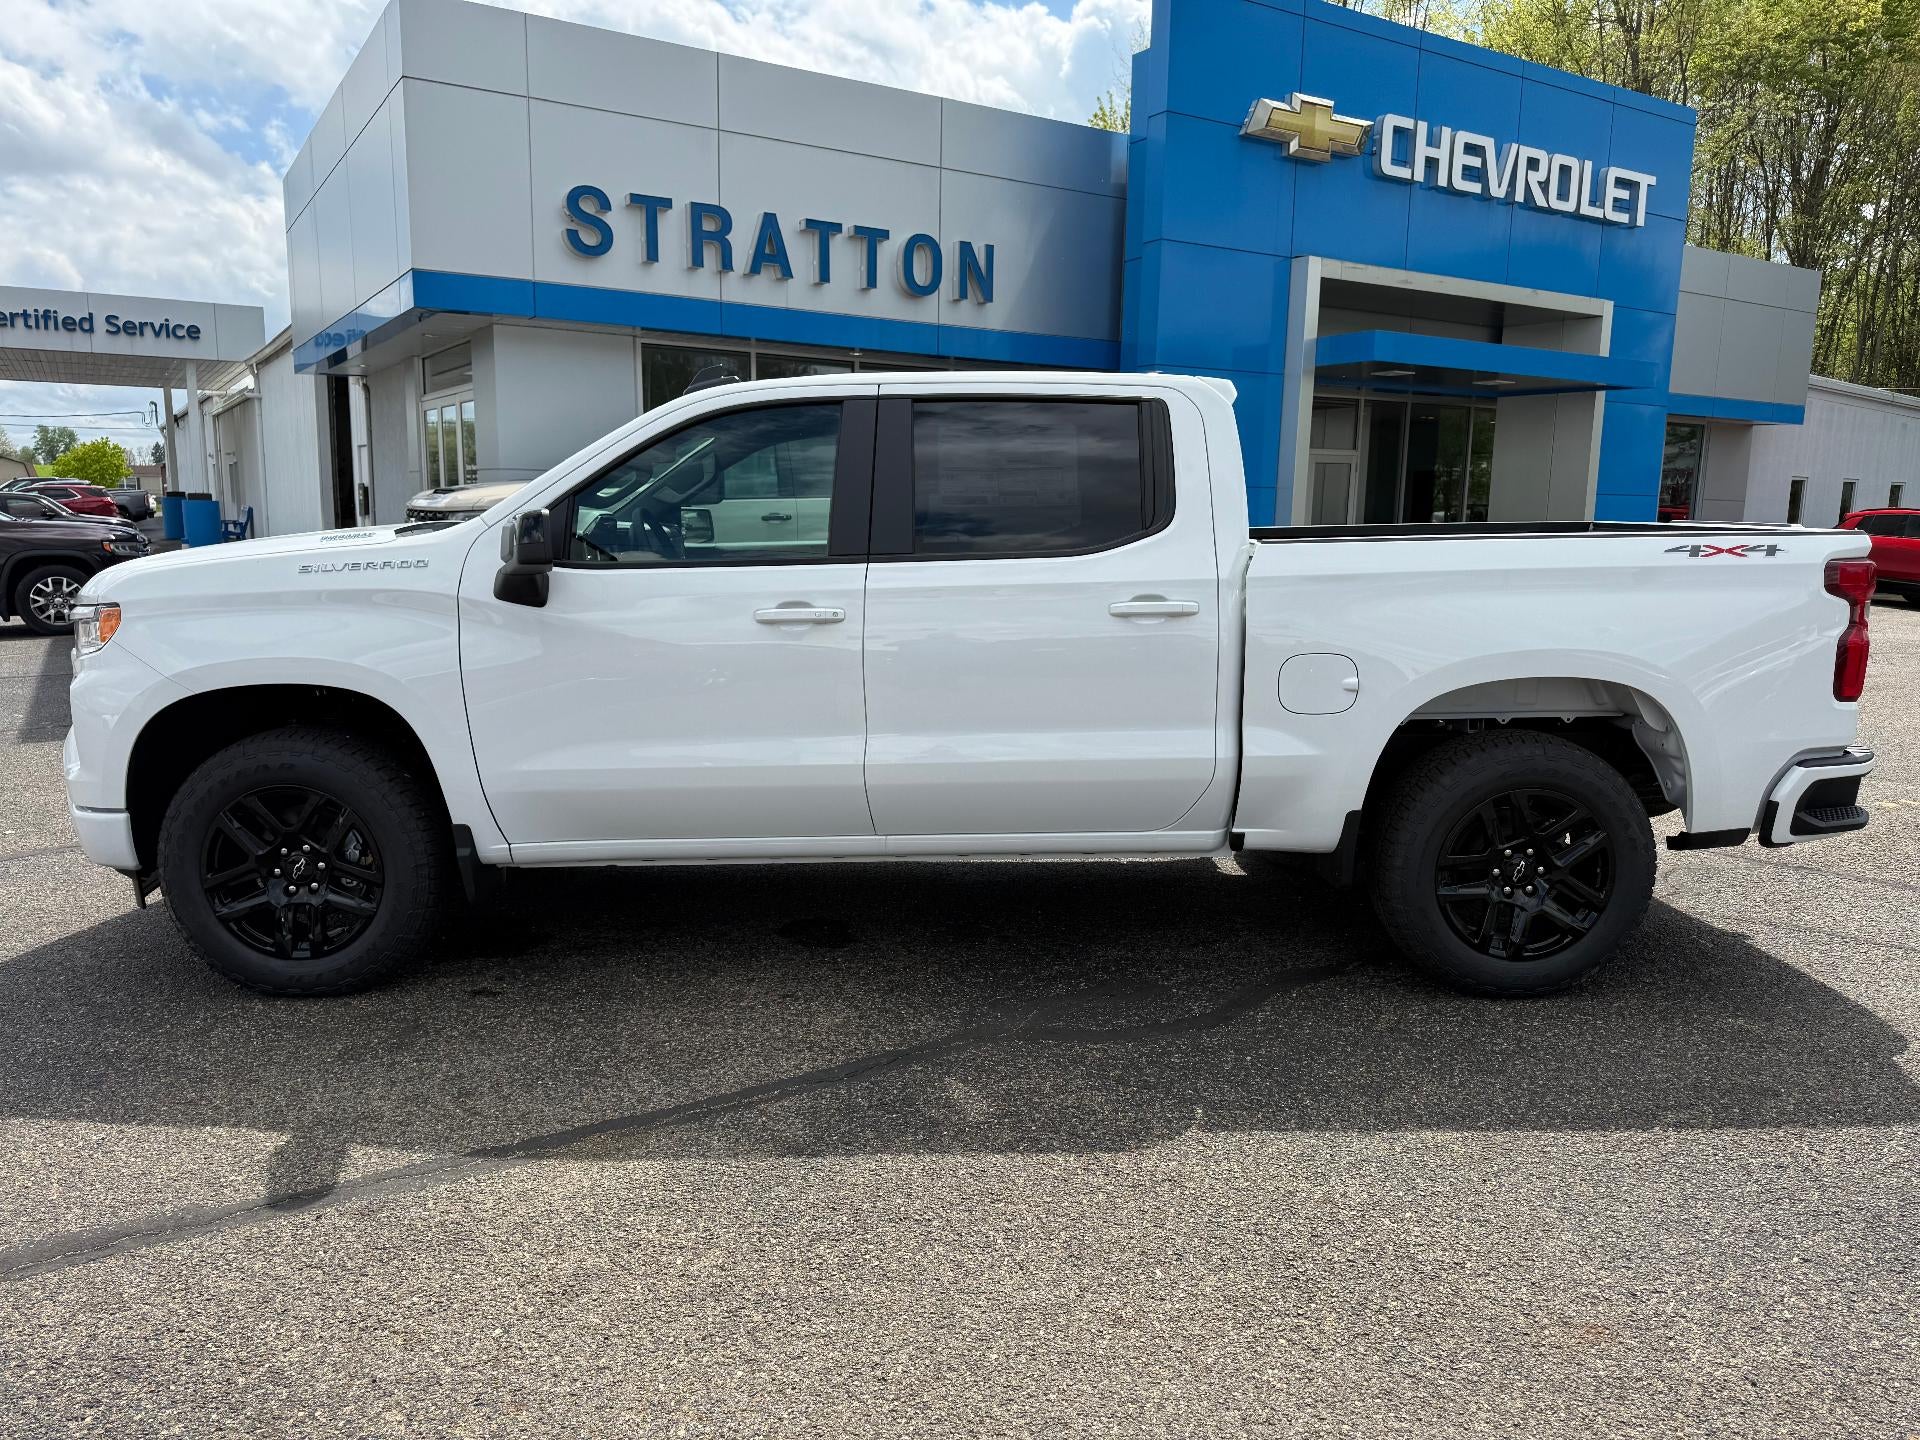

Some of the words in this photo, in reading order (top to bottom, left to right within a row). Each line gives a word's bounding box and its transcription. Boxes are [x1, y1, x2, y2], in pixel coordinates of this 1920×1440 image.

[1376, 113, 1657, 227] CHEVROLET
[563, 185, 995, 304] STRATTON
[104, 314, 201, 340] Service
[298, 559, 429, 574] SILVERADO
